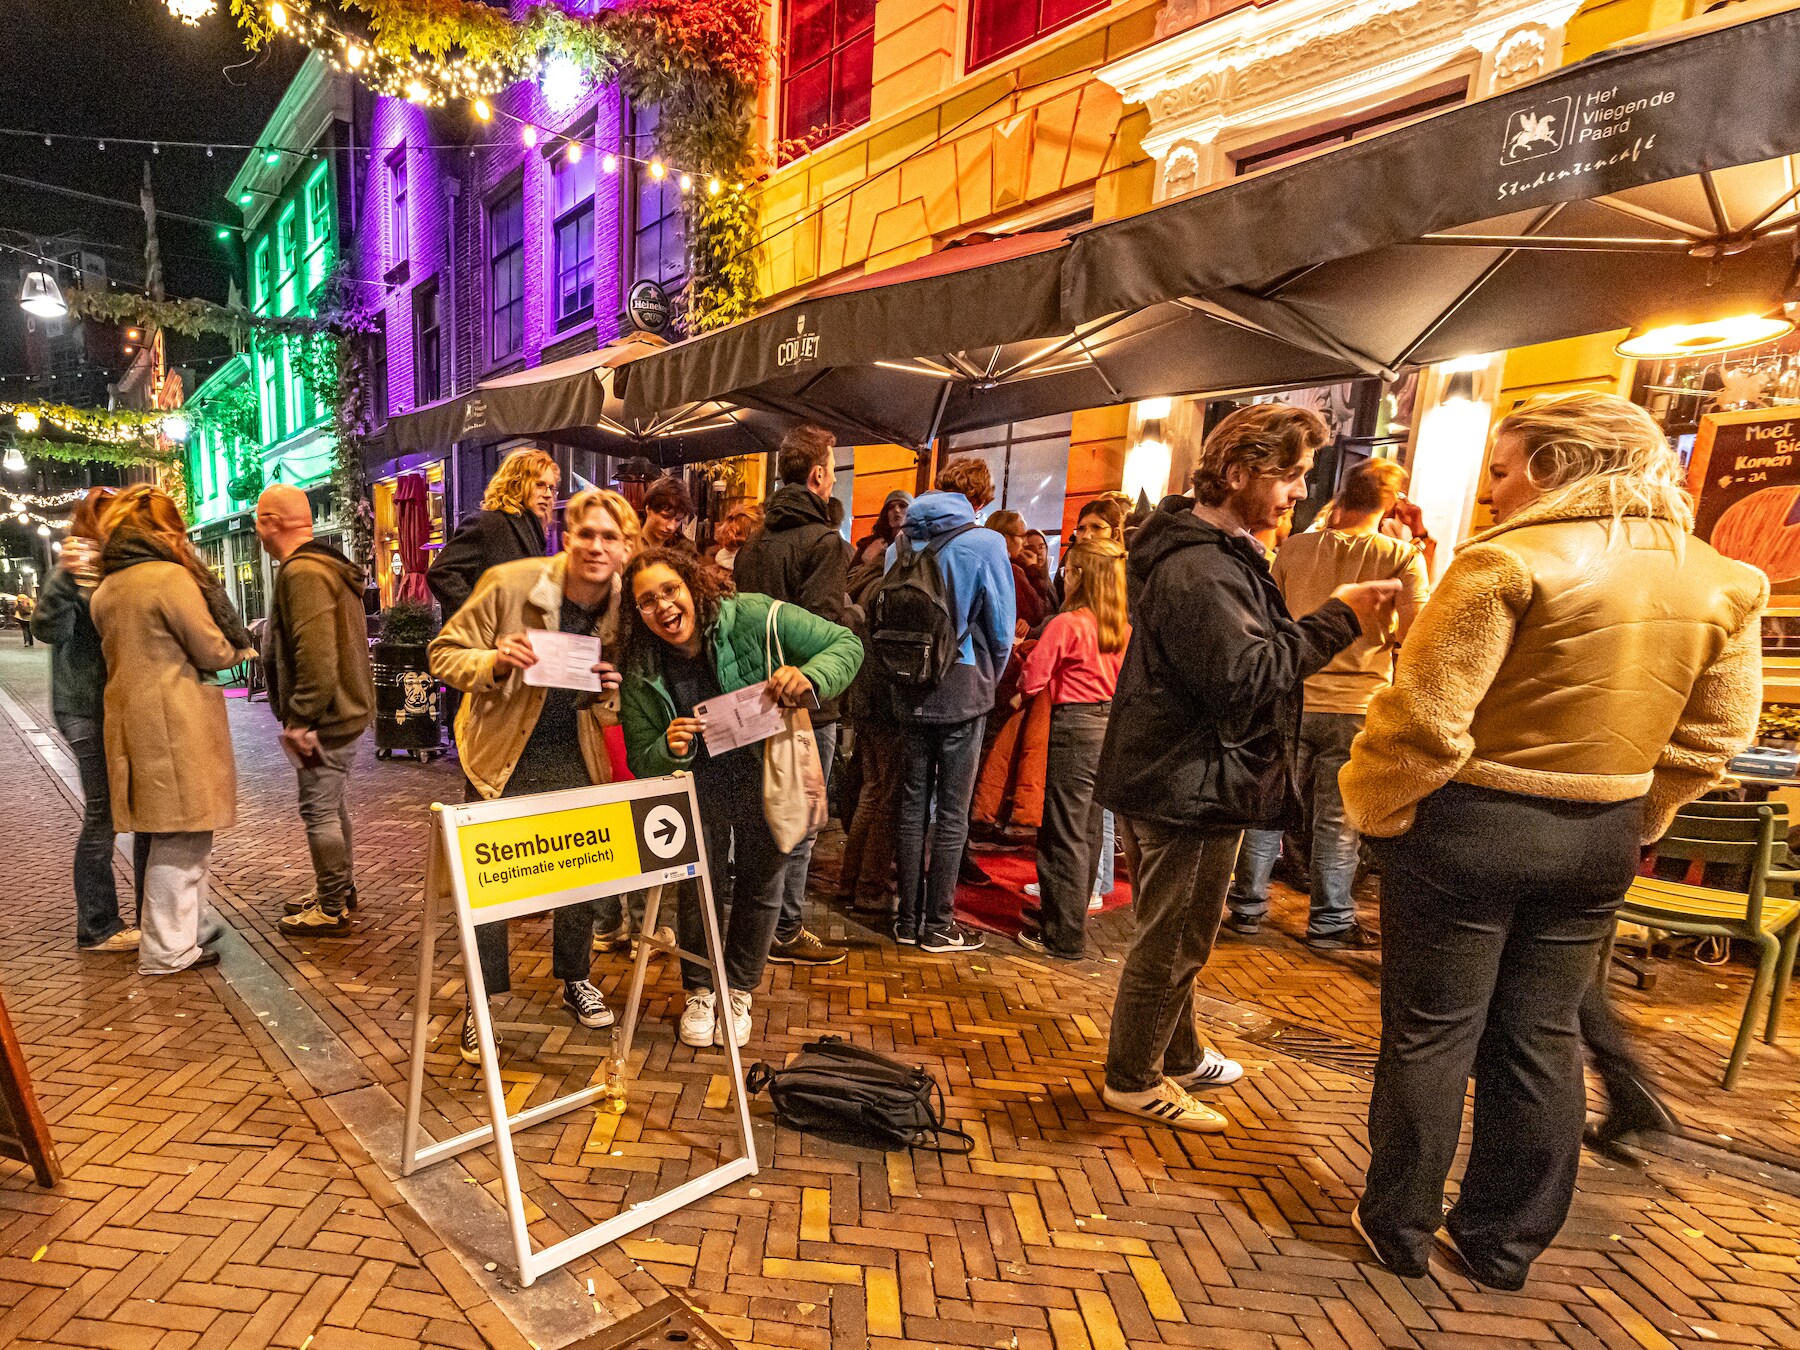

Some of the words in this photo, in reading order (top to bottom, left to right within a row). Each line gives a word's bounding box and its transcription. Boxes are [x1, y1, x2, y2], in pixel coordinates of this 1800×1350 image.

[1586, 86, 1619, 106] Het
[1579, 118, 1631, 143] Paard
[1498, 134, 1656, 200] Studentencafé
[1745, 422, 1794, 441] Moet
[1734, 455, 1793, 470] Komen
[1748, 471, 1767, 483] JA
[475, 827, 611, 865] Stembureau
[478, 860, 555, 887] (Legitimatie
[558, 848, 615, 870] verplicht)
